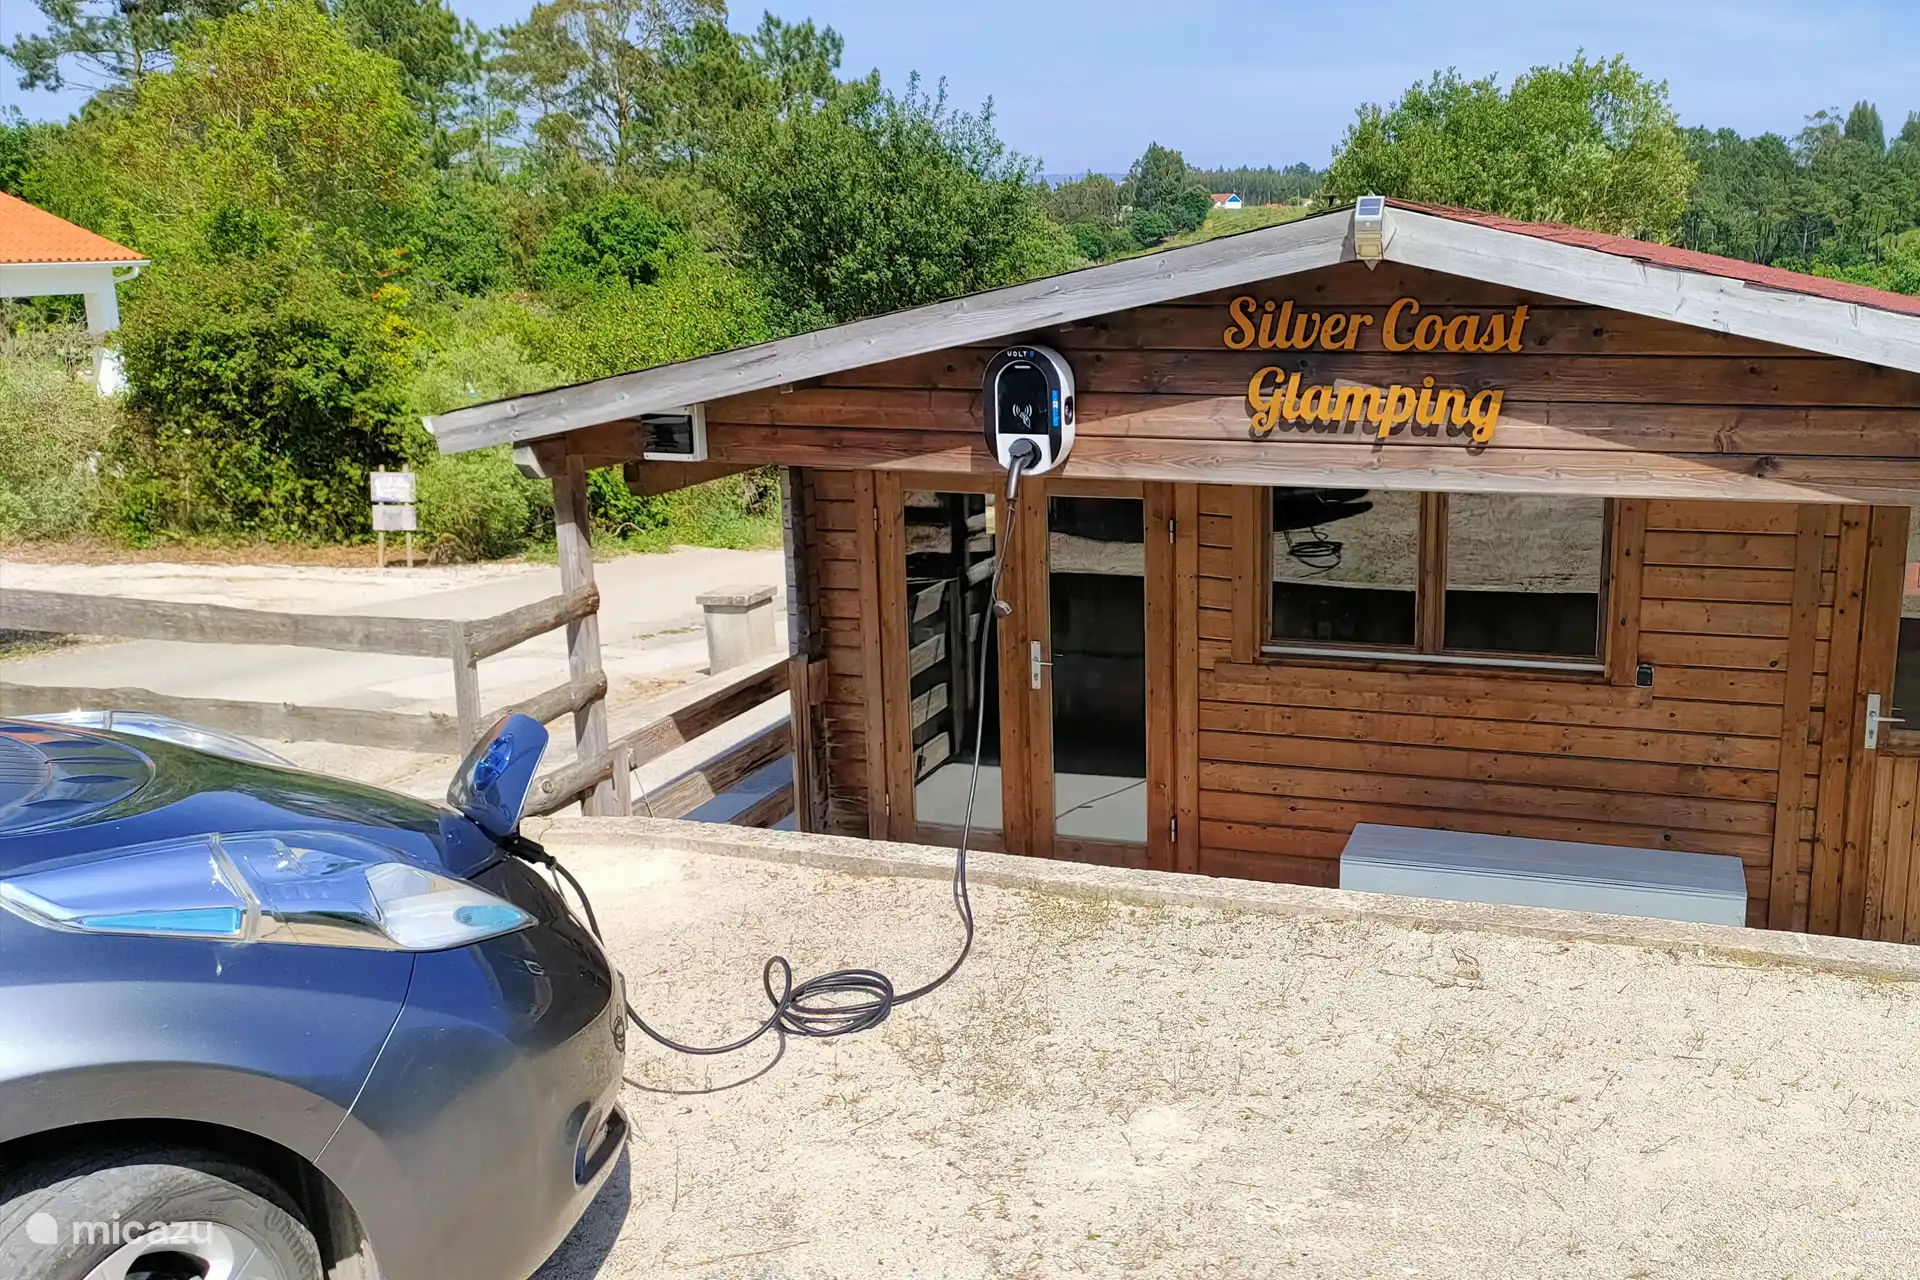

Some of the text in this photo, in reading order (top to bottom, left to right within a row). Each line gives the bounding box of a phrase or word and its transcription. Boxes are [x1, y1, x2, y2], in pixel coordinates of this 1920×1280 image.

[1223, 296, 1530, 353] Silver Coast
[1248, 366, 1505, 442] Glamping
